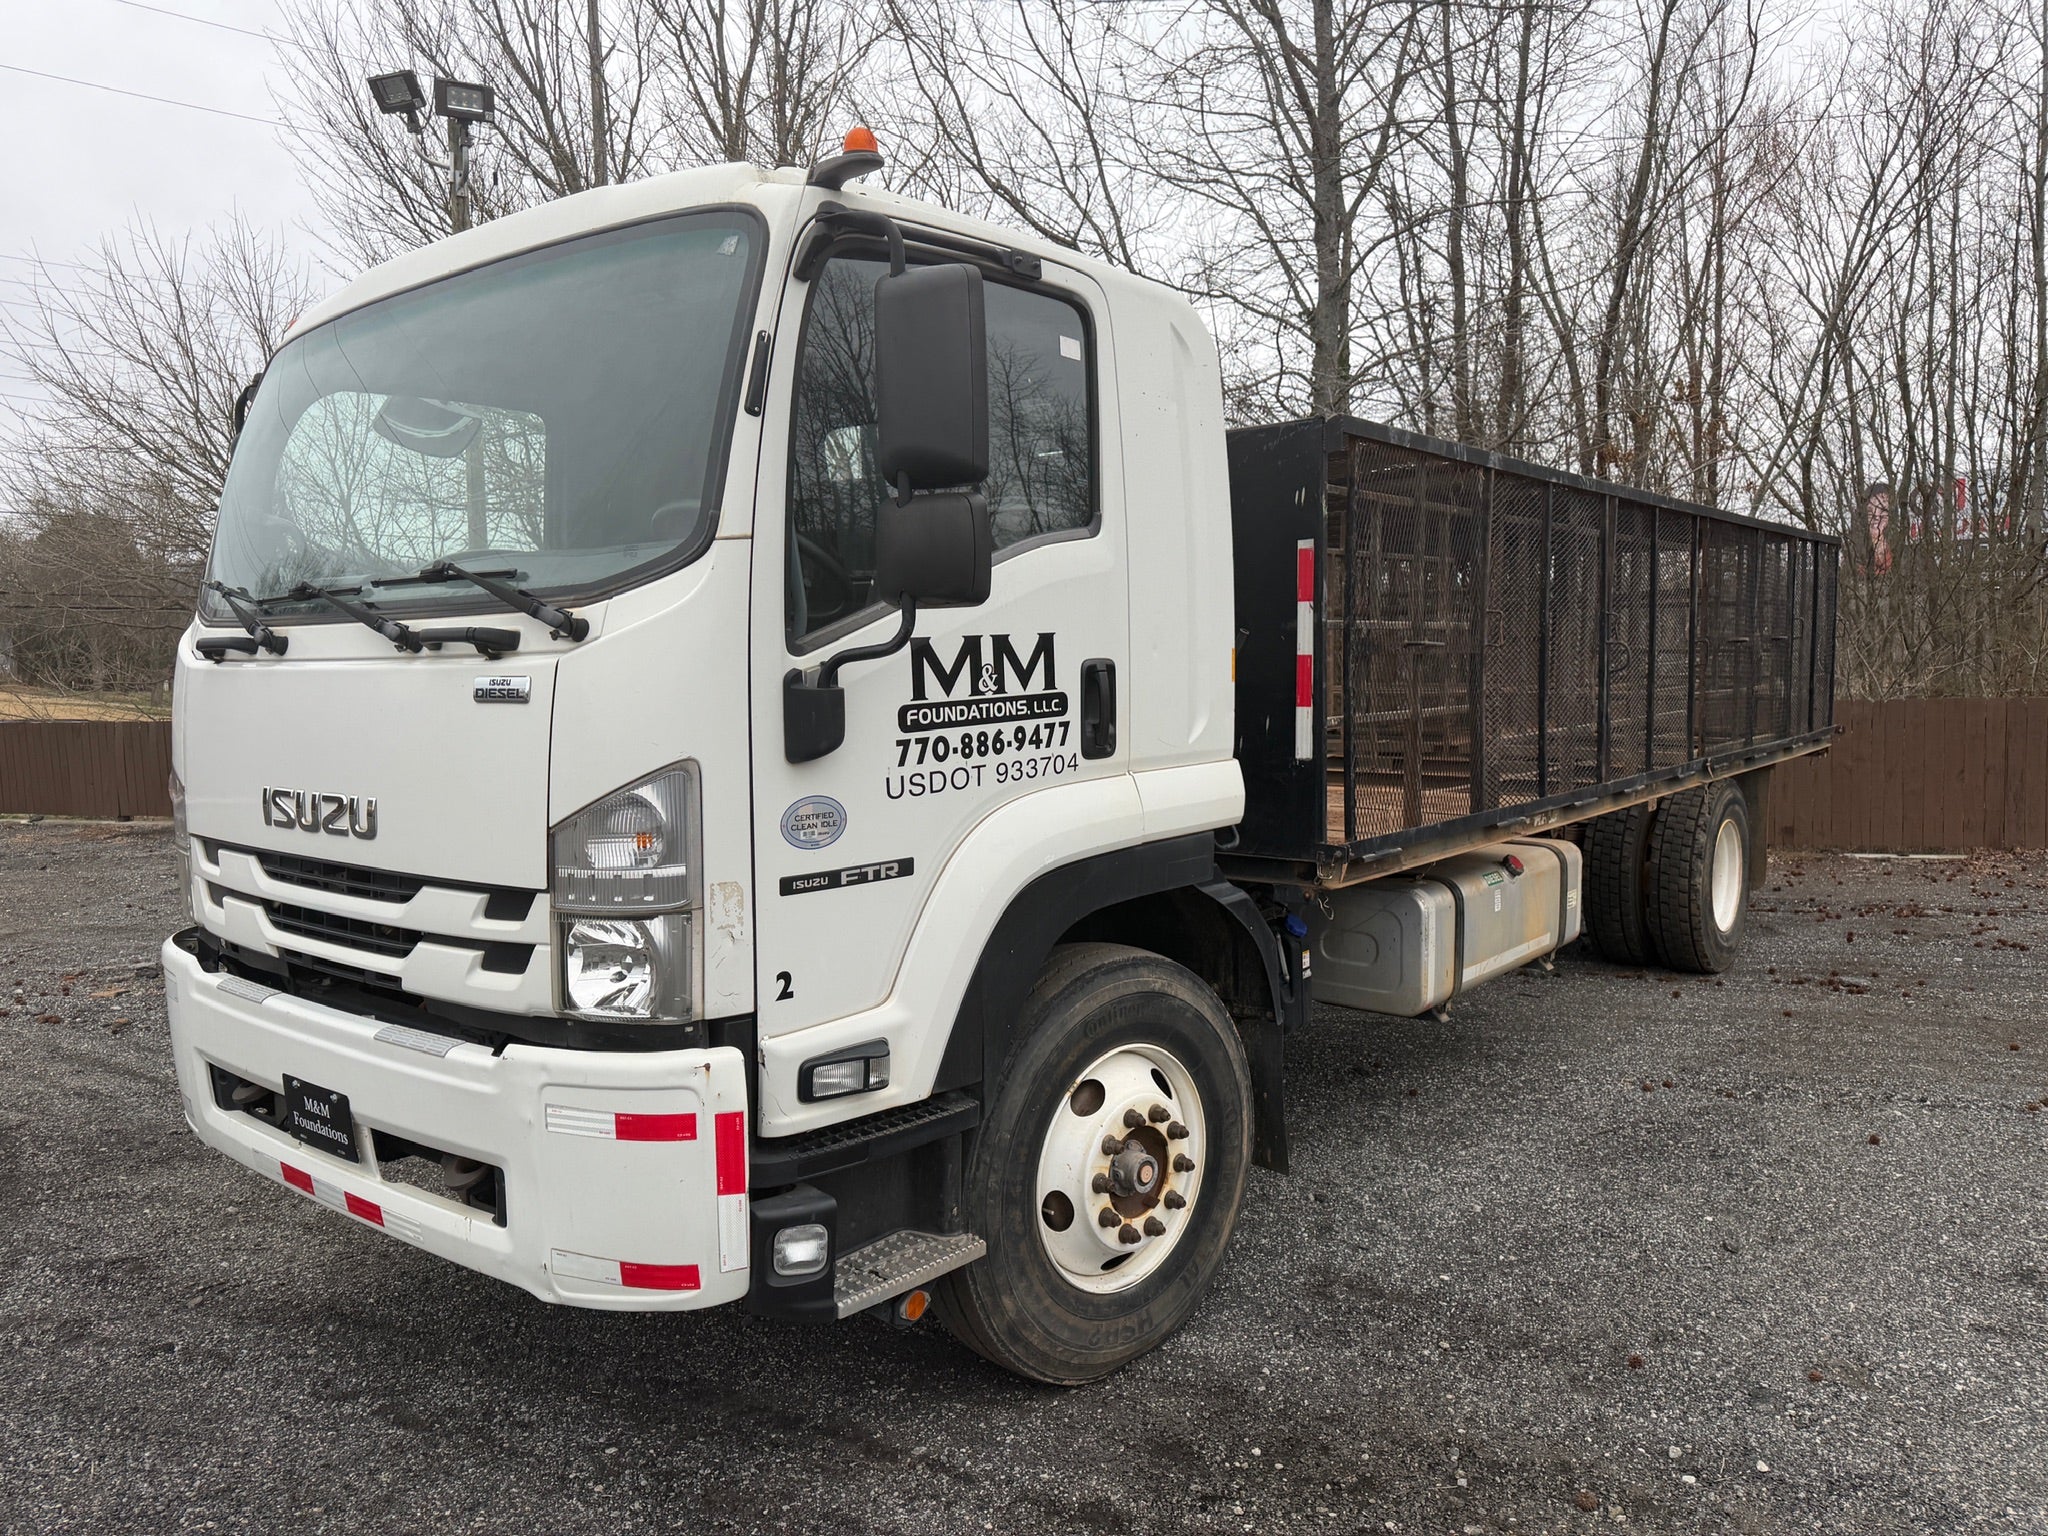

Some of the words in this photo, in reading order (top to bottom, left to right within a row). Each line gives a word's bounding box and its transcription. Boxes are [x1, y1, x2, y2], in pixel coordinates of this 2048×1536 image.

[909, 632, 1058, 702] M&M
[475, 688, 525, 699] DIESEL
[488, 679, 512, 687] ISUZU
[1033, 699, 1062, 714] L.L.C.
[895, 721, 1070, 768] 770-886-9477
[885, 764, 987, 800] USDOT
[995, 752, 1079, 784] 933704
[262, 785, 378, 841] ISUZU
[790, 822, 818, 831] CLEAN
[820, 820, 838, 828] IDLE
[794, 811, 834, 822] CERTIFIED
[792, 876, 829, 890] ISUZU
[840, 862, 899, 885] FTR
[775, 971, 794, 1002] 2
[303, 1095, 330, 1118] M&M
[293, 1111, 348, 1145] Foundations
